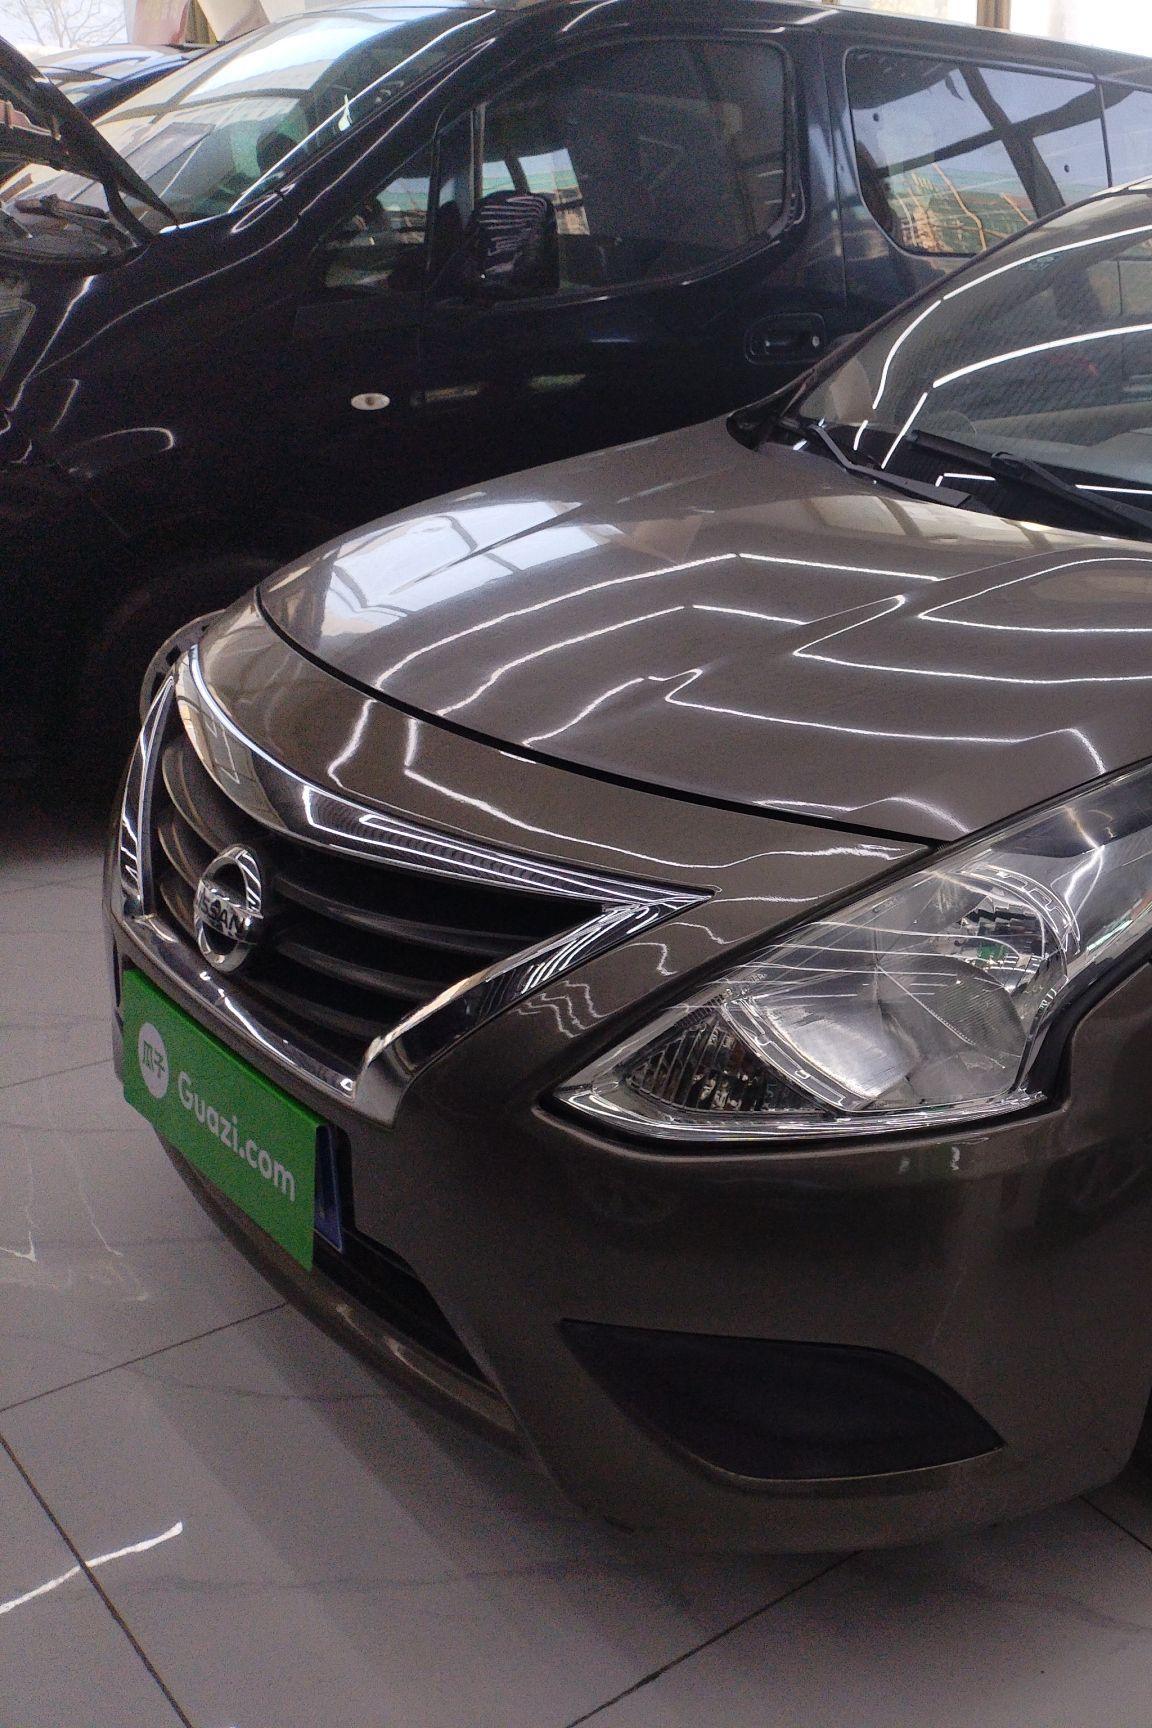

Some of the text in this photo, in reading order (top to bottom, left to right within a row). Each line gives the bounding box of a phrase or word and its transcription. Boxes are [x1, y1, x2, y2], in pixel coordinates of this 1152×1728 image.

[199, 885, 247, 938] SSAN
[142, 1040, 167, 1080] 瓜子
[177, 1070, 296, 1202] Guazi.com
